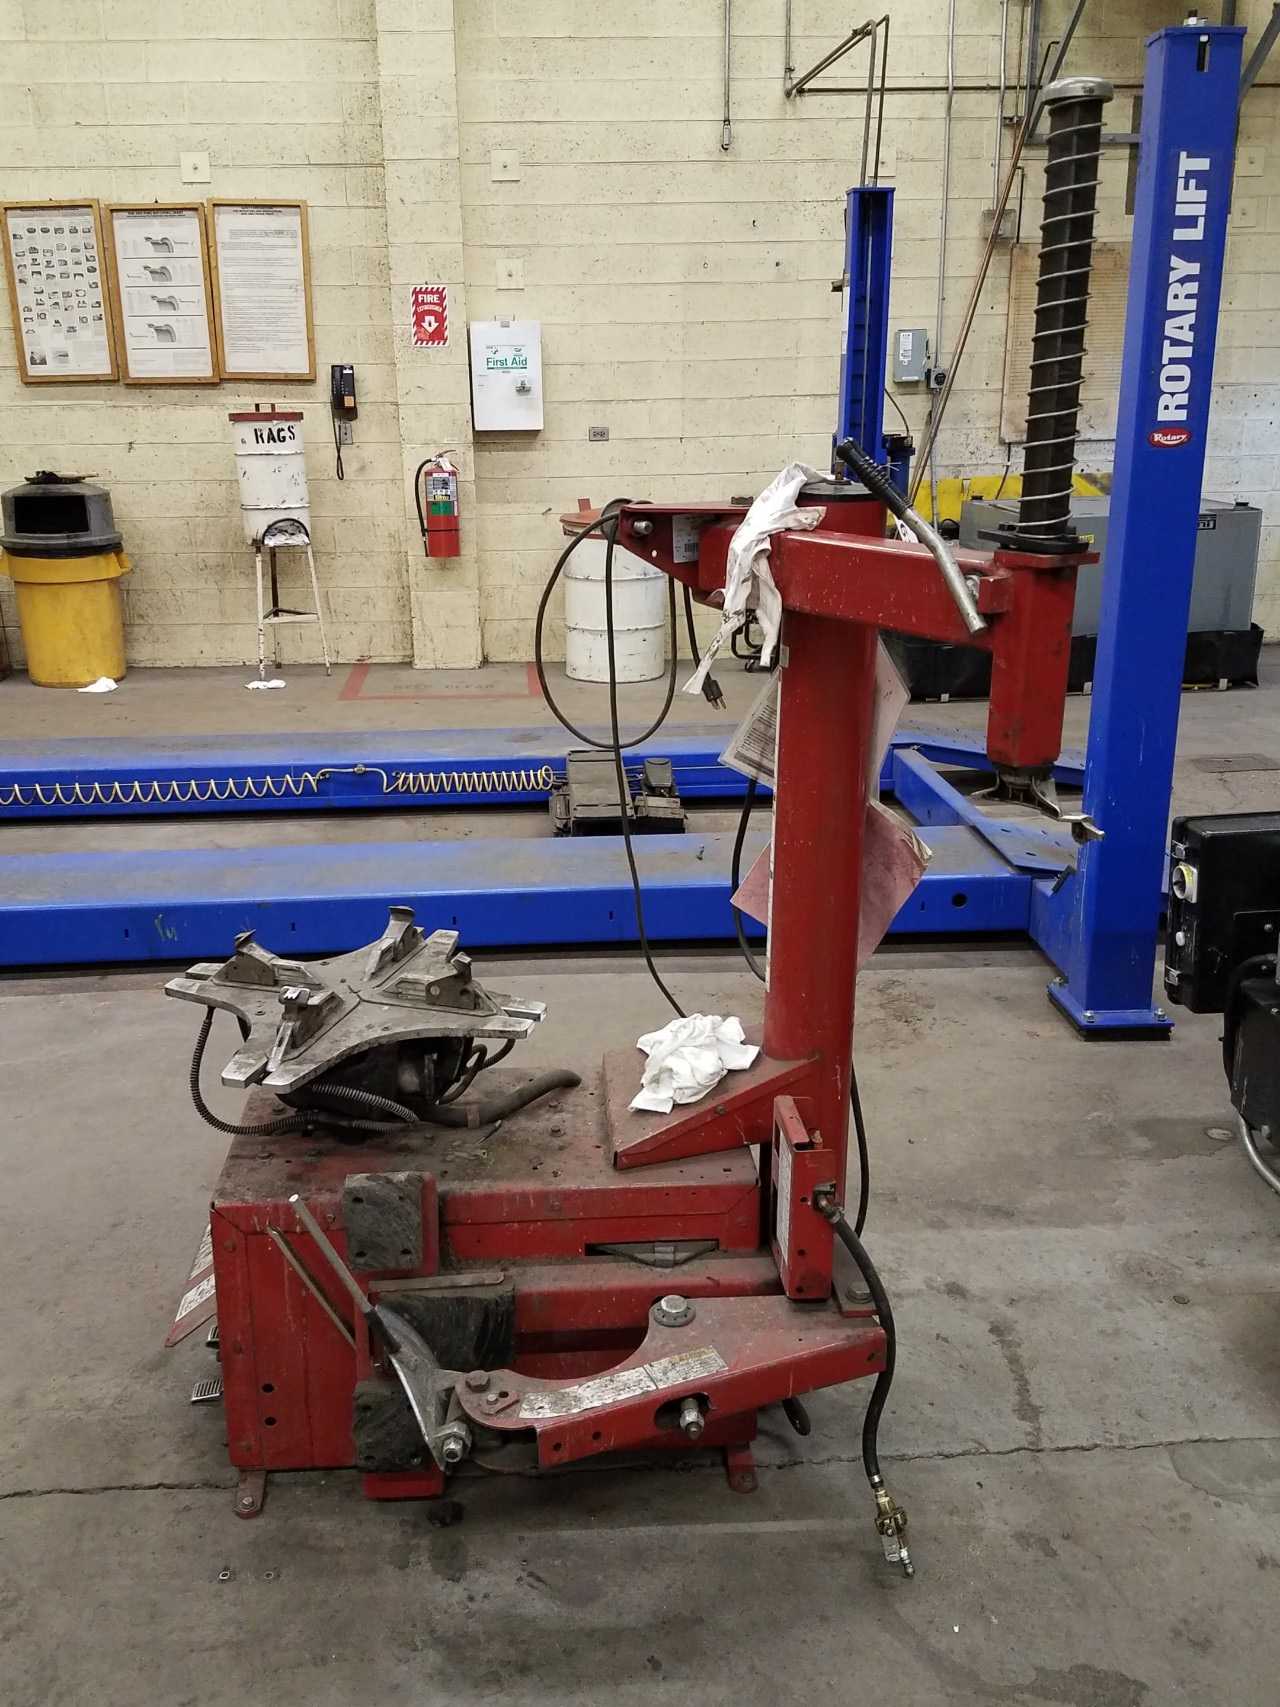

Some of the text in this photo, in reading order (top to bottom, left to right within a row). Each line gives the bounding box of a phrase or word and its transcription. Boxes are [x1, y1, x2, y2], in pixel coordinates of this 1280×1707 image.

[1157, 151, 1211, 422] ROTARY LIFT
[418, 294, 441, 303] FIRE
[486, 356, 528, 366] First Aid
[253, 424, 296, 445] RAGS
[1153, 432, 1188, 444] Rotary
